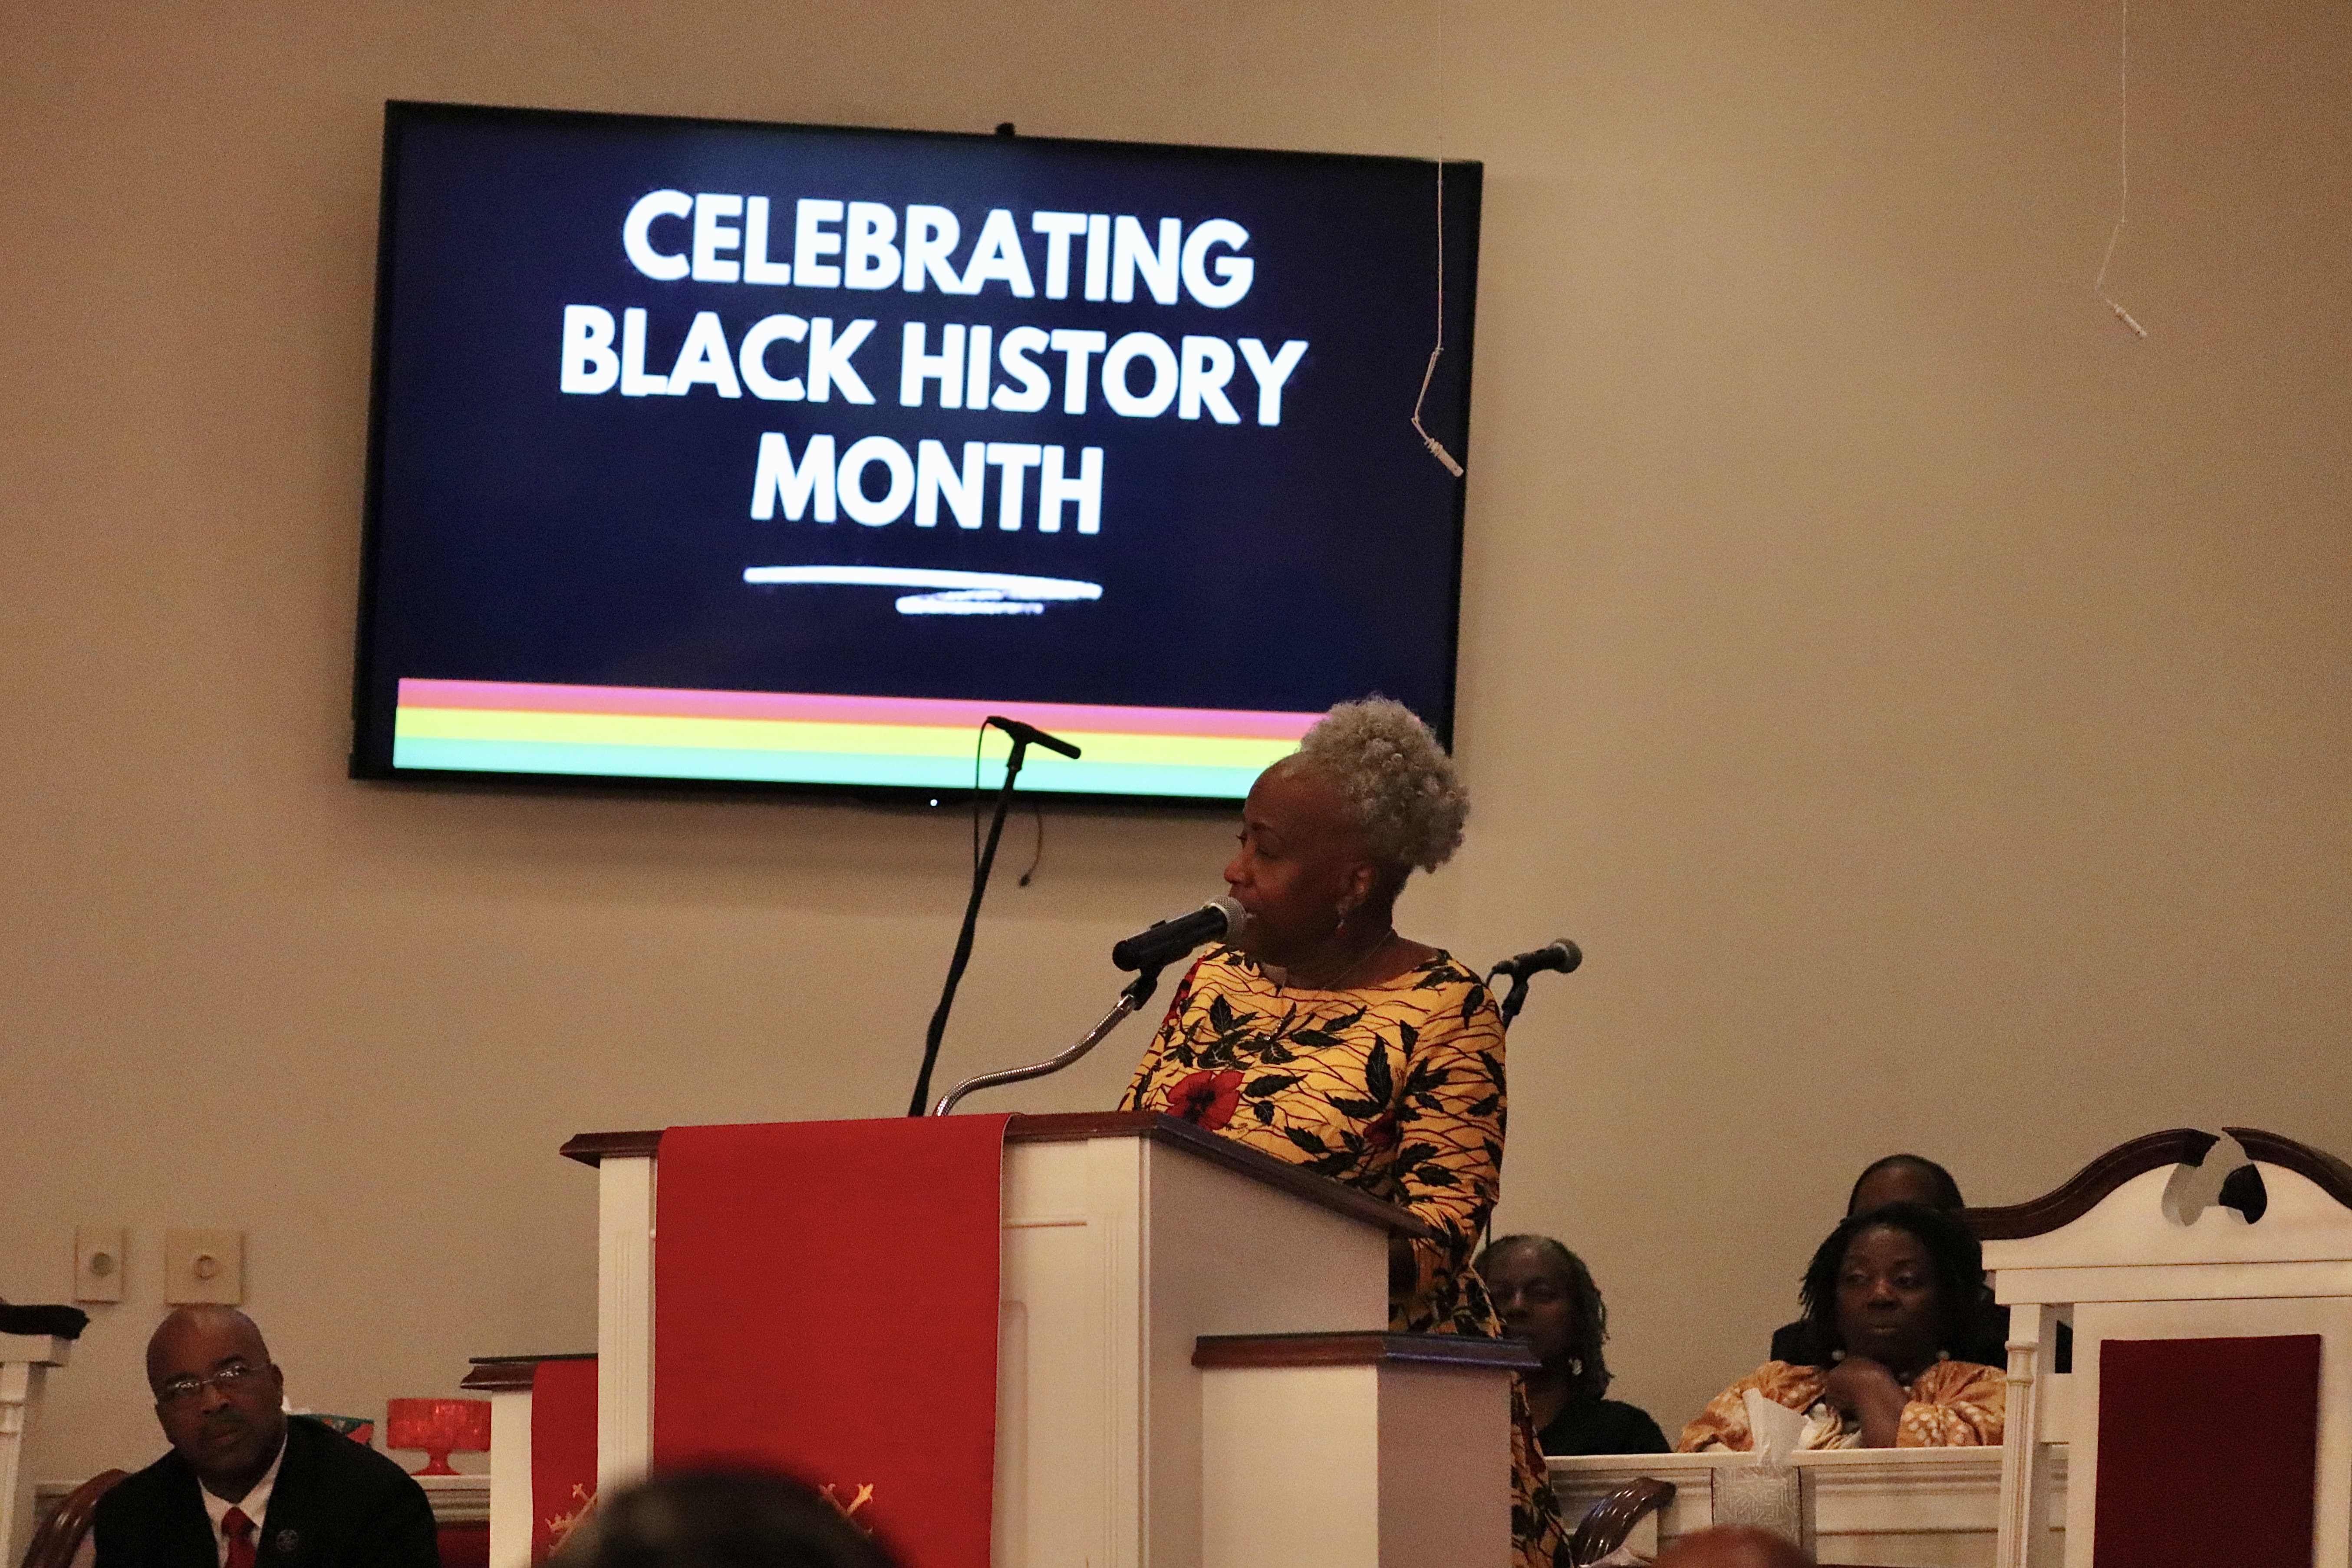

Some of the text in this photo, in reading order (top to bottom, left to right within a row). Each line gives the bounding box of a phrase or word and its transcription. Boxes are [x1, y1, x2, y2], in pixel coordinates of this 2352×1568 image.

[623, 190, 1253, 307] CELEBRATING
[560, 305, 1308, 426] BLACK HISTORY
[751, 432, 1104, 534] MONTH
